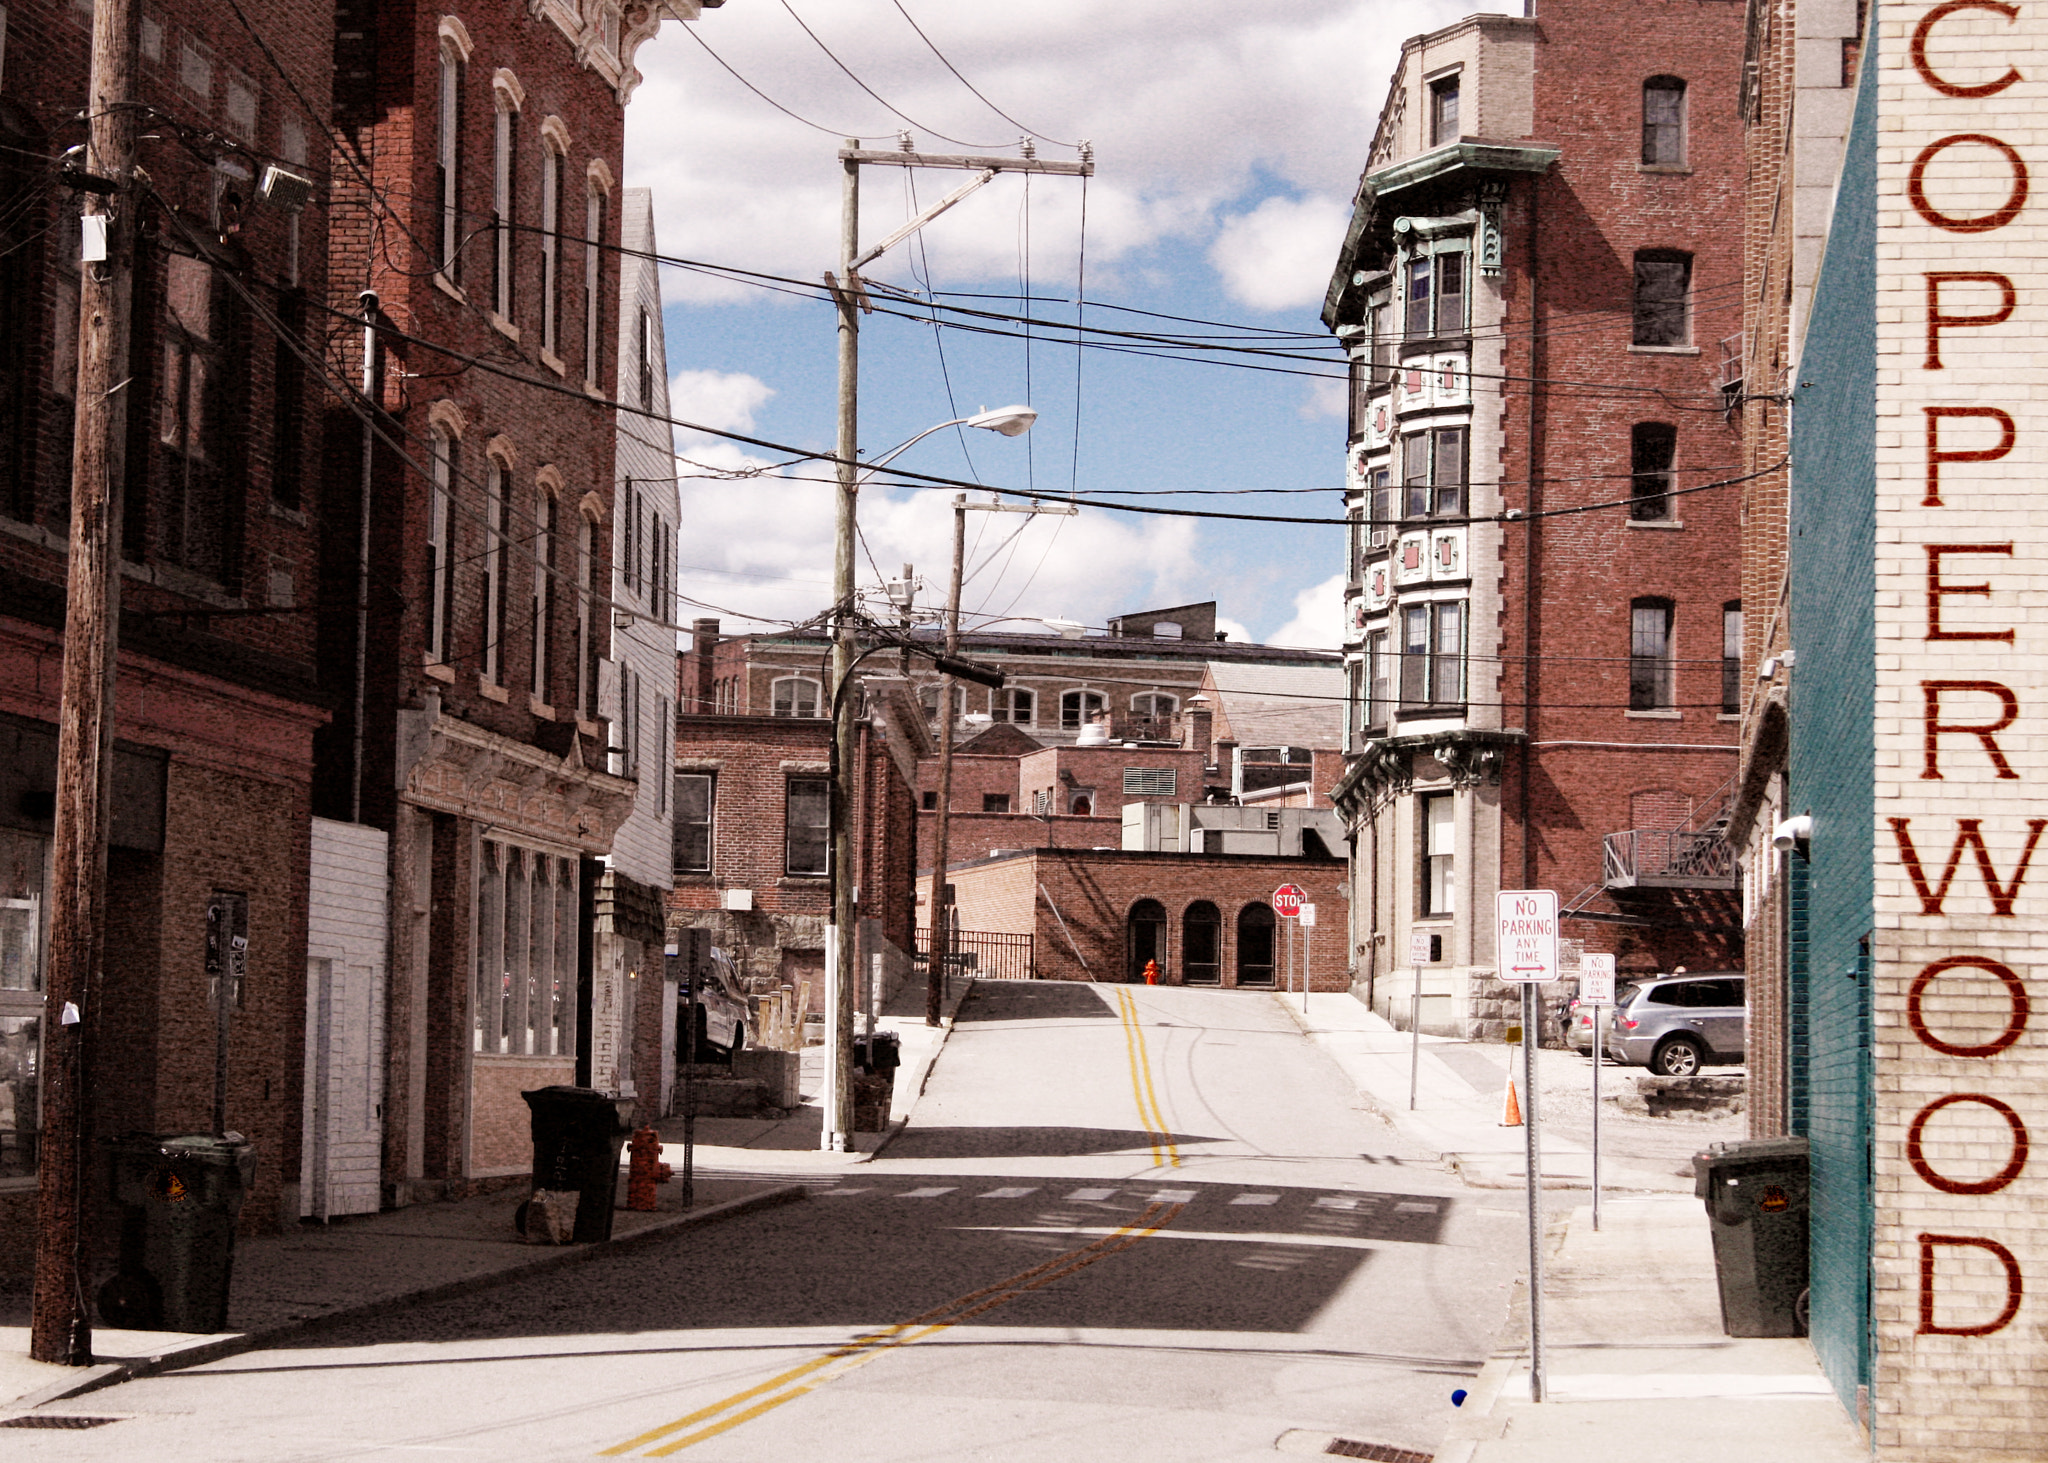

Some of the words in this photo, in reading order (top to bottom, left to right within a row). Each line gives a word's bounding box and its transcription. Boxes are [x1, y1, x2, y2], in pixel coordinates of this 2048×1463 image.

[1888, 0, 2048, 1337] COPPERWOOD
[1276, 894, 1304, 907] STOP
[1516, 900, 1537, 916] NO
[1502, 919, 1552, 935] PARKING
[1516, 938, 1538, 949] ANY
[1515, 952, 1540, 963] TIME
[1592, 959, 1603, 969] NO
[1584, 970, 1611, 979] PARKING
